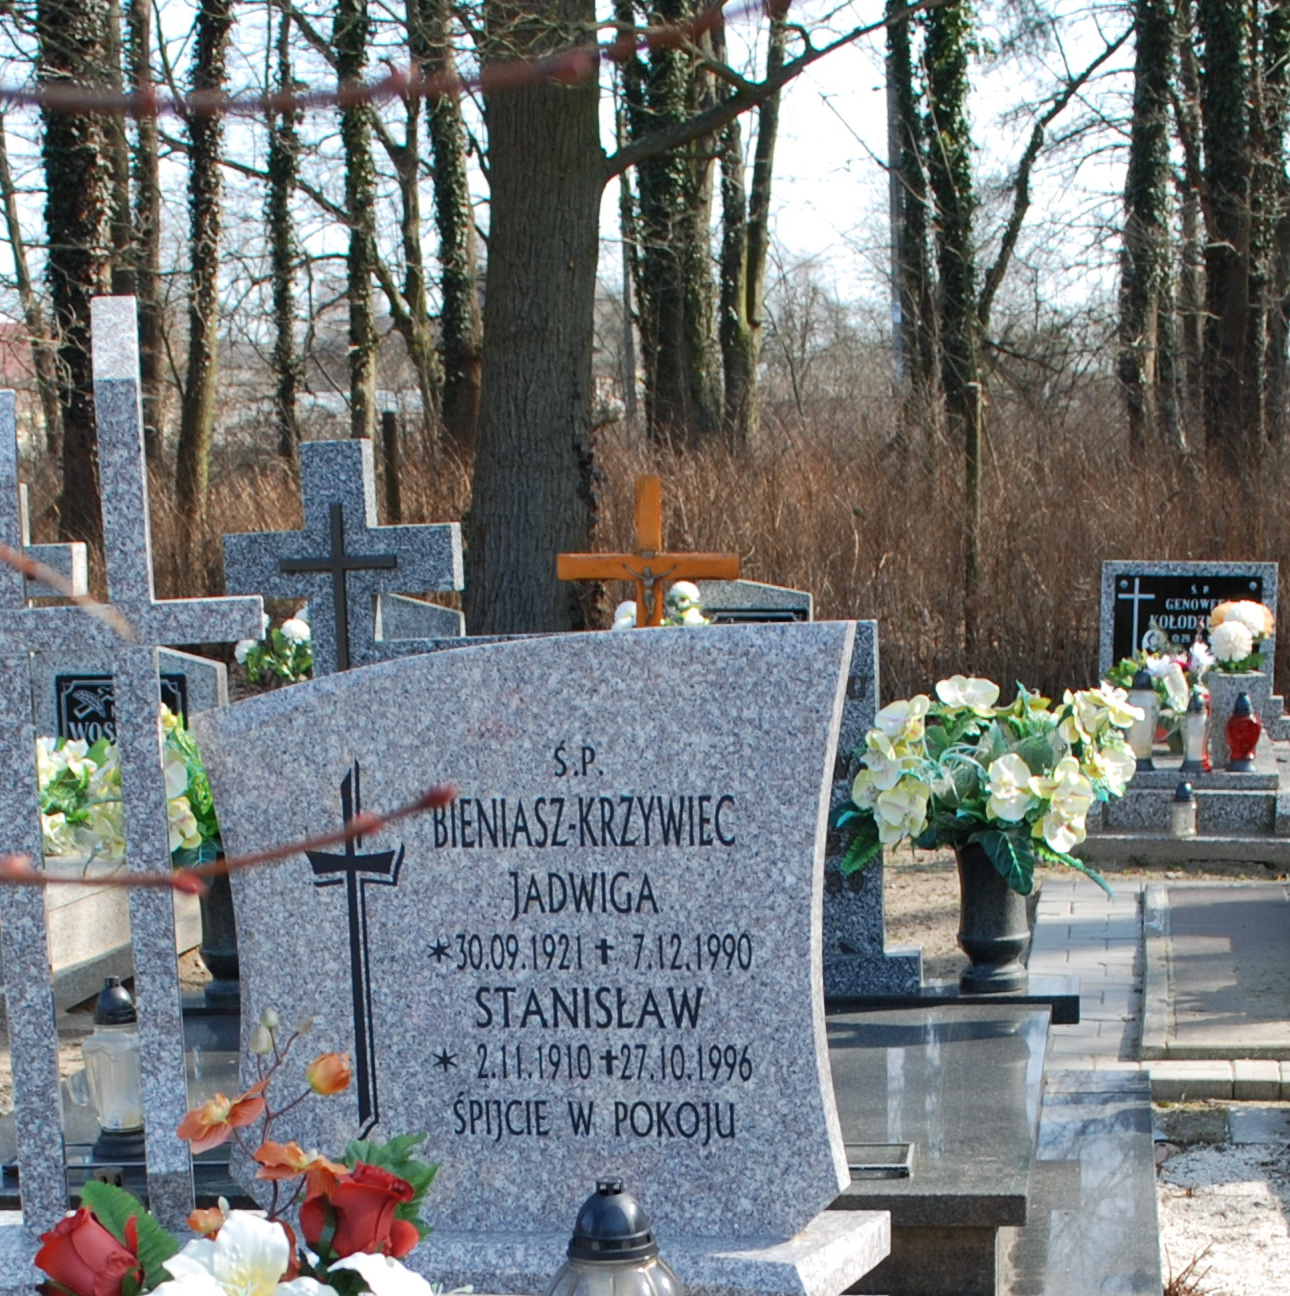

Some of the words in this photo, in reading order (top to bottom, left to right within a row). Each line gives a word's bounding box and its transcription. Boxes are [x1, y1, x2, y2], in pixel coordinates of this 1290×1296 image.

[433, 795, 737, 849] BIENIASZ-KRZYWIEC
[509, 871, 660, 921] JADWIGA
[633, 933, 753, 970] 7.12.1990
[475, 987, 704, 1030] STANISŁAW
[477, 1043, 592, 1080] 2.11.1910
[452, 1092, 550, 1143] ŚPIJCIE
[568, 1101, 594, 1136] W
[614, 1101, 736, 1146] POKOJU
